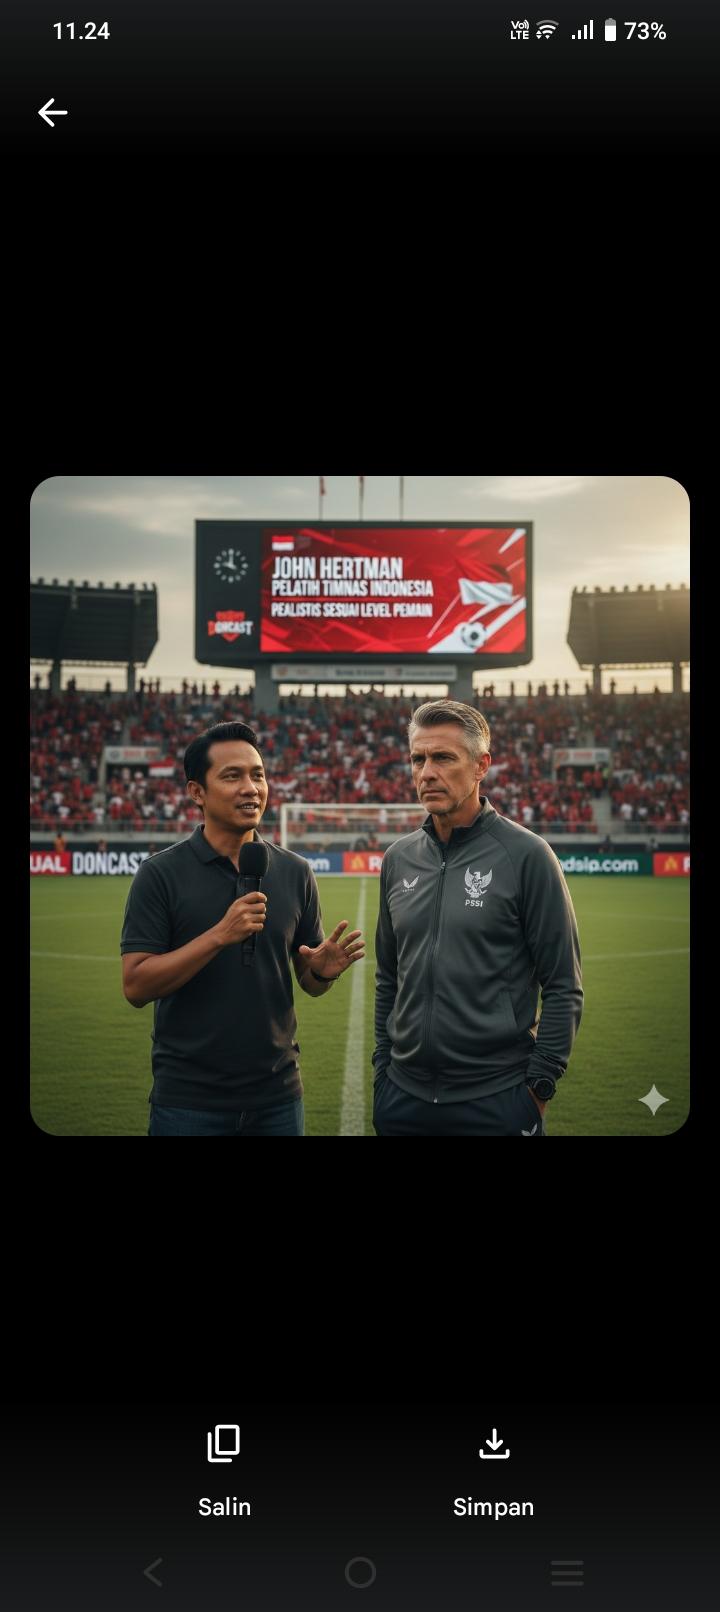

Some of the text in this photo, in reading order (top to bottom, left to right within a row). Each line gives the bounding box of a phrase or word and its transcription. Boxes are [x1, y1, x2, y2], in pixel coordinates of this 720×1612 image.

[272, 556, 403, 579] JOHN HERTMAN
[271, 579, 434, 597] PELATIH TIMNAS INDONESIA
[322, 602, 360, 617] SESUAI
[360, 602, 392, 617] LEVEL
[393, 602, 433, 618] PEMAIN
[464, 899, 484, 908] PSSI
